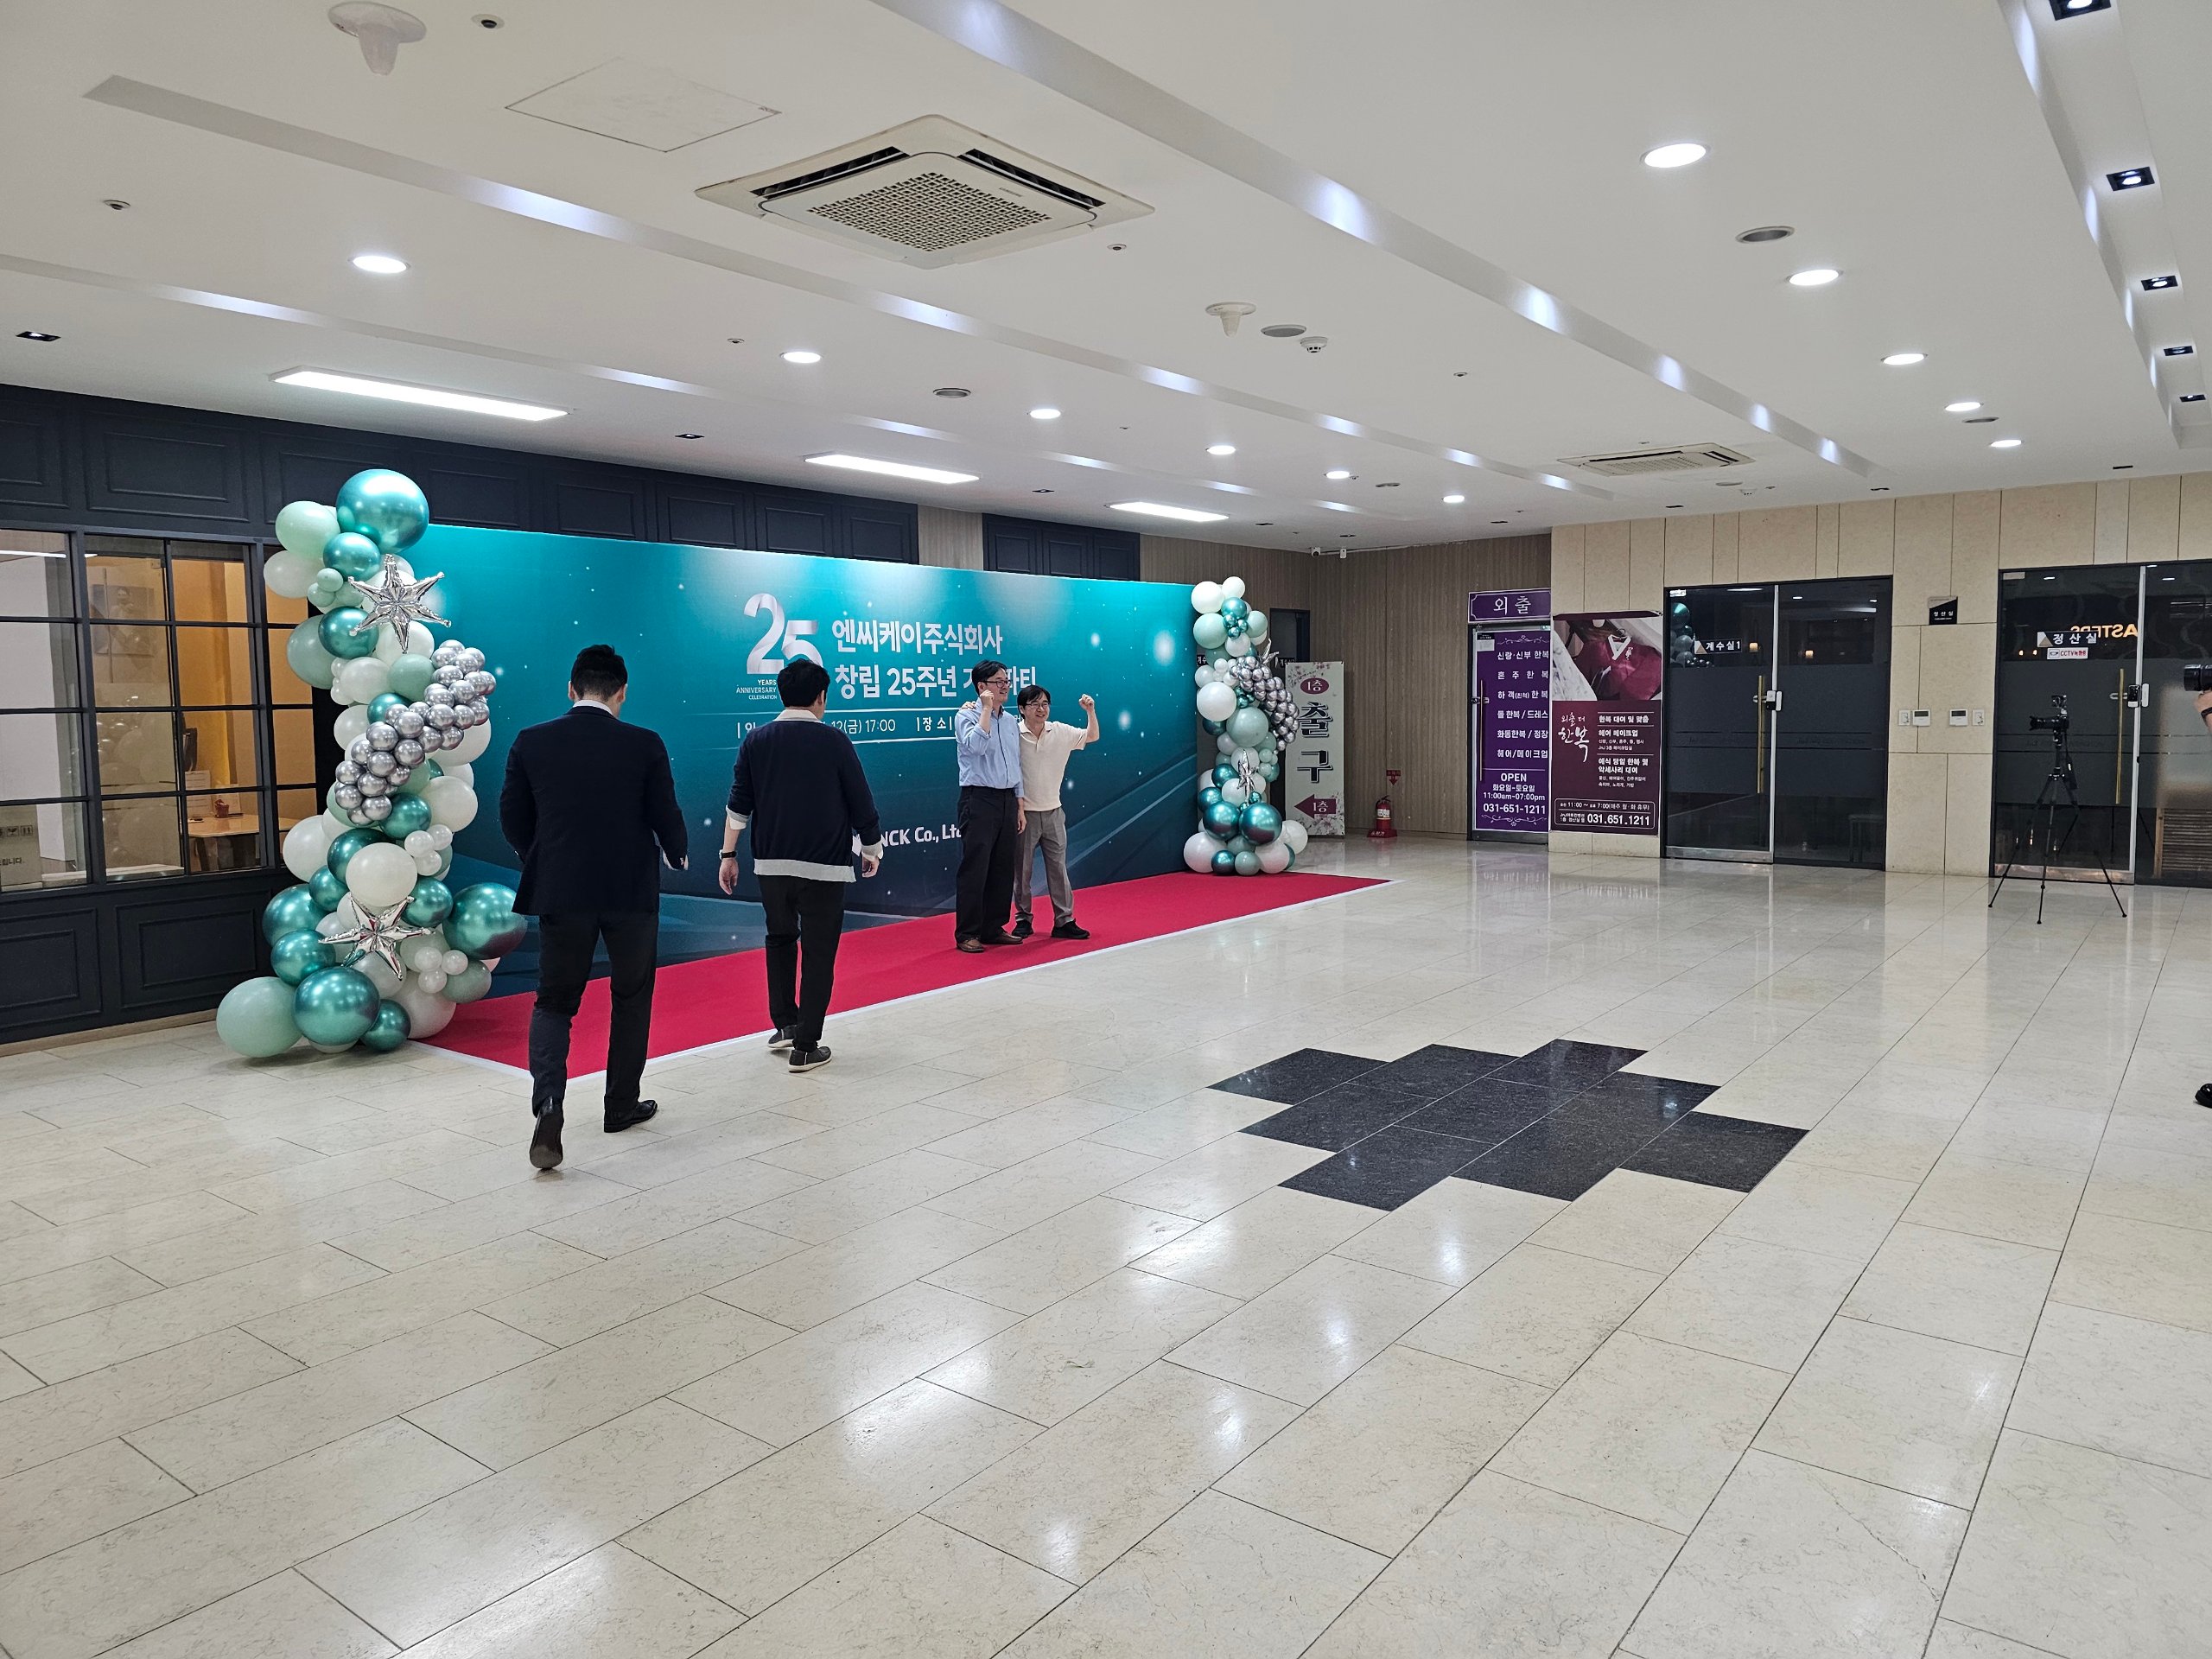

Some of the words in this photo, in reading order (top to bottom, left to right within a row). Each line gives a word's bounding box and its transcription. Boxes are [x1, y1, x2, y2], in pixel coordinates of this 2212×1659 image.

[1493, 595, 1531, 615] 외출
[744, 593, 823, 675] 25
[831, 619, 1003, 655] 엔씨케이주식회사
[2052, 632, 2097, 645] 정산실
[1706, 640, 1741, 652] 계수실1
[1535, 650, 1549, 659] 한복
[835, 664, 880, 699] 창립
[887, 665, 957, 698] 25주년
[1306, 680, 1322, 692] 1층
[1527, 710, 1548, 719] 드레스
[865, 719, 896, 733] 17:00
[1534, 730, 1548, 739] 정장
[1500, 772, 1527, 782] OPEN
[1313, 801, 1329, 813] 1층
[1483, 803, 1546, 814] 031-651-1211
[1587, 813, 1649, 825] 031.651.1211
[880, 829, 911, 847] NCK
[915, 826, 939, 843] Co.,
